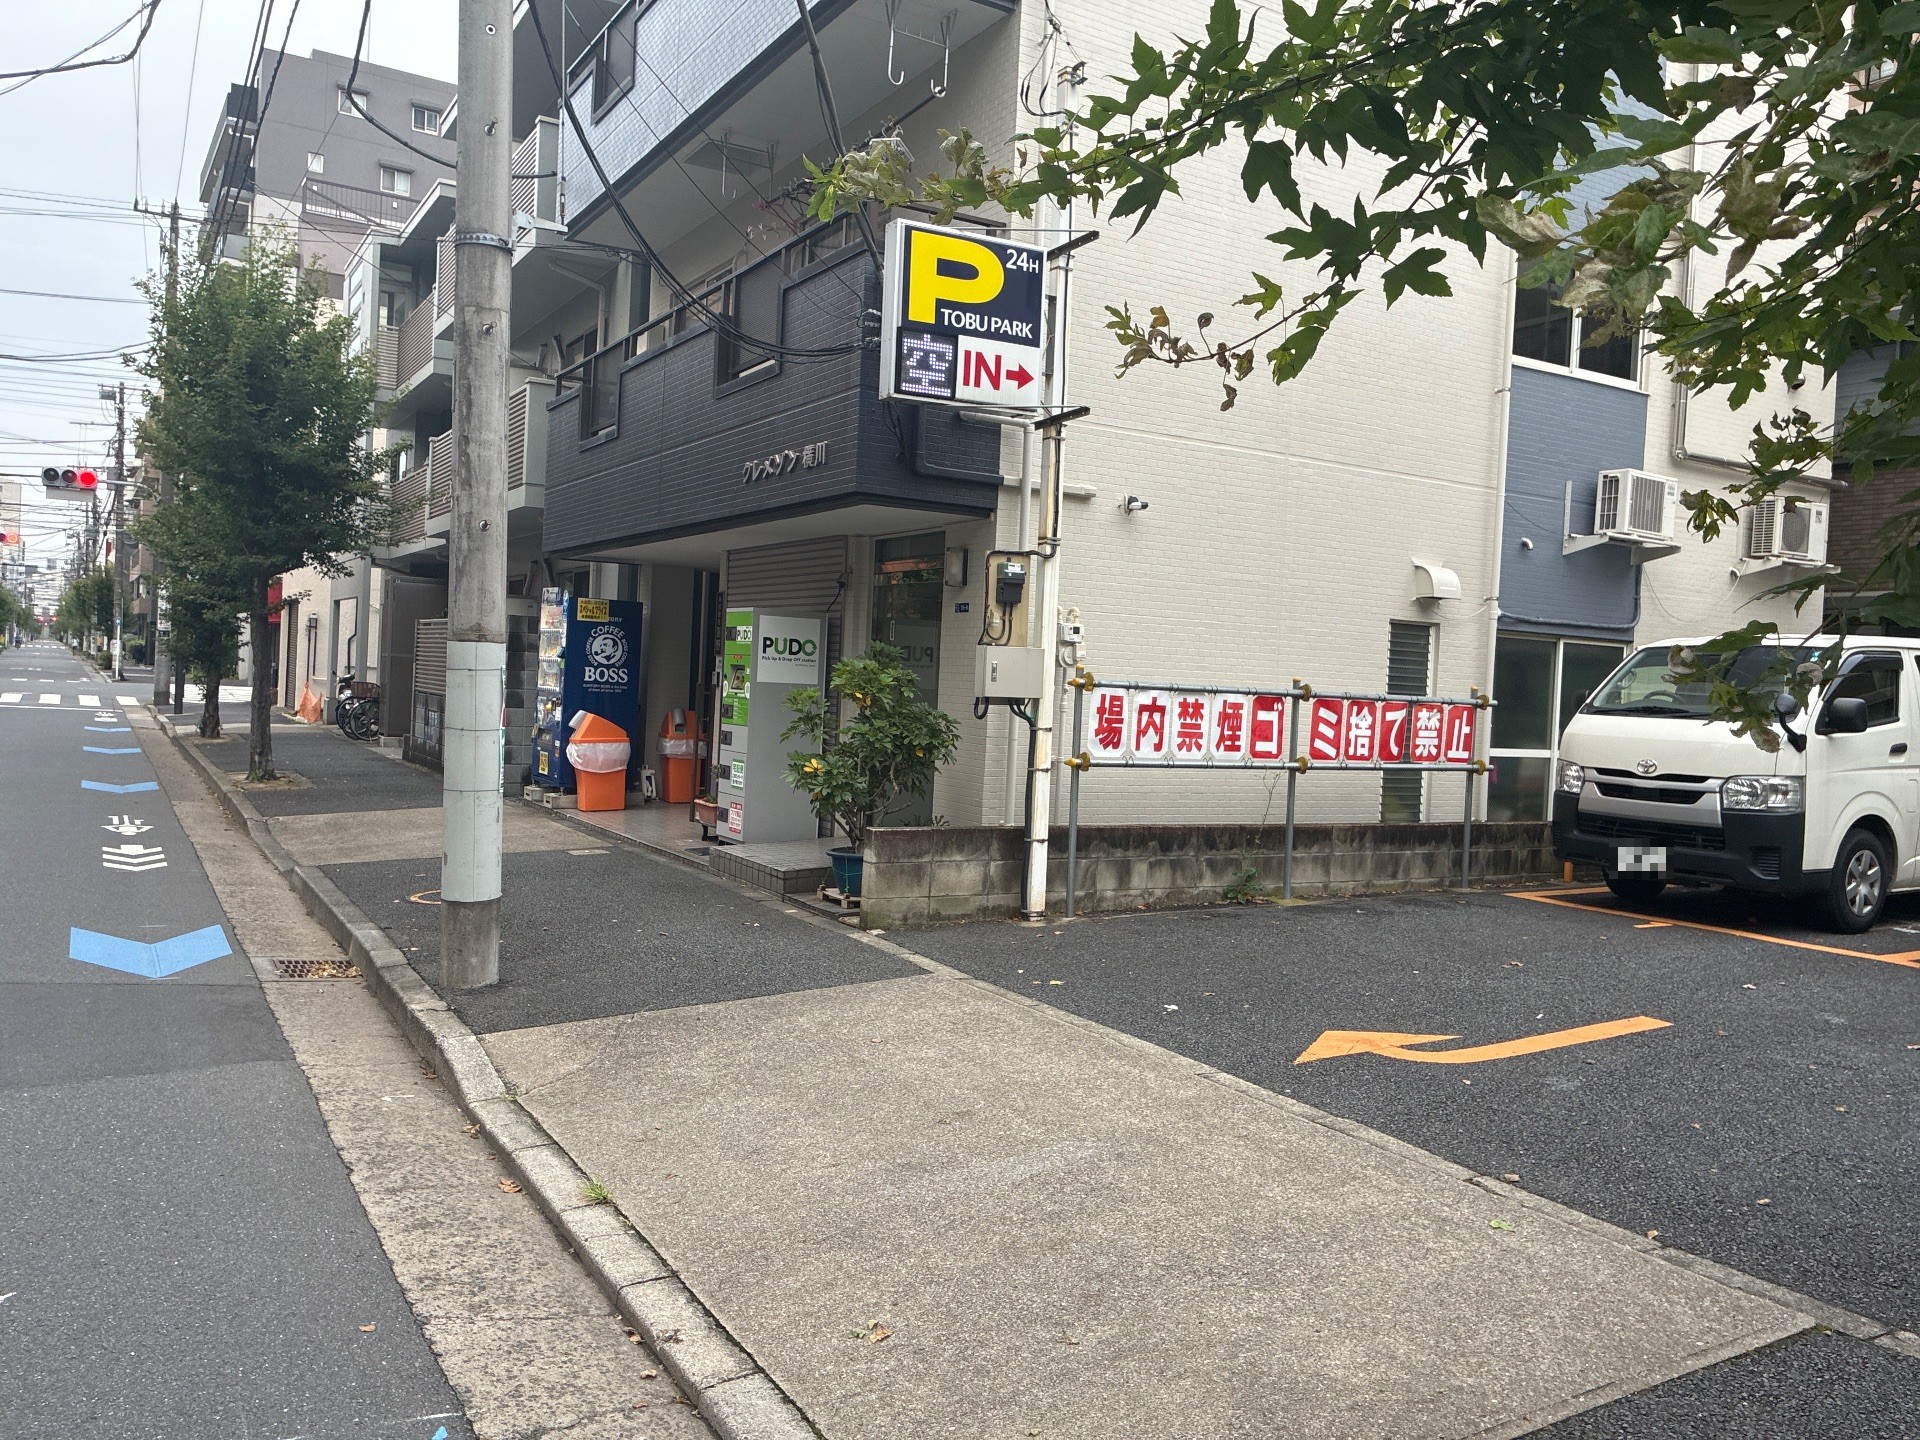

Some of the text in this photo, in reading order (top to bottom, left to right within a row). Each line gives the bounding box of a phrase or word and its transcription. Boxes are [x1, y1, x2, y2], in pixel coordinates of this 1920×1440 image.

[908, 230, 1005, 324] P
[1005, 249, 1039, 274] 24H
[940, 308, 1033, 339] TOBU PARK
[902, 333, 953, 397] 空
[962, 349, 1002, 391] IN
[591, 625, 625, 639] COFFEE
[762, 636, 818, 657] PUDO
[584, 667, 629, 683] BOSS
[1094, 693, 1471, 760] 場内禁煙 ゴミ捨て禁止
